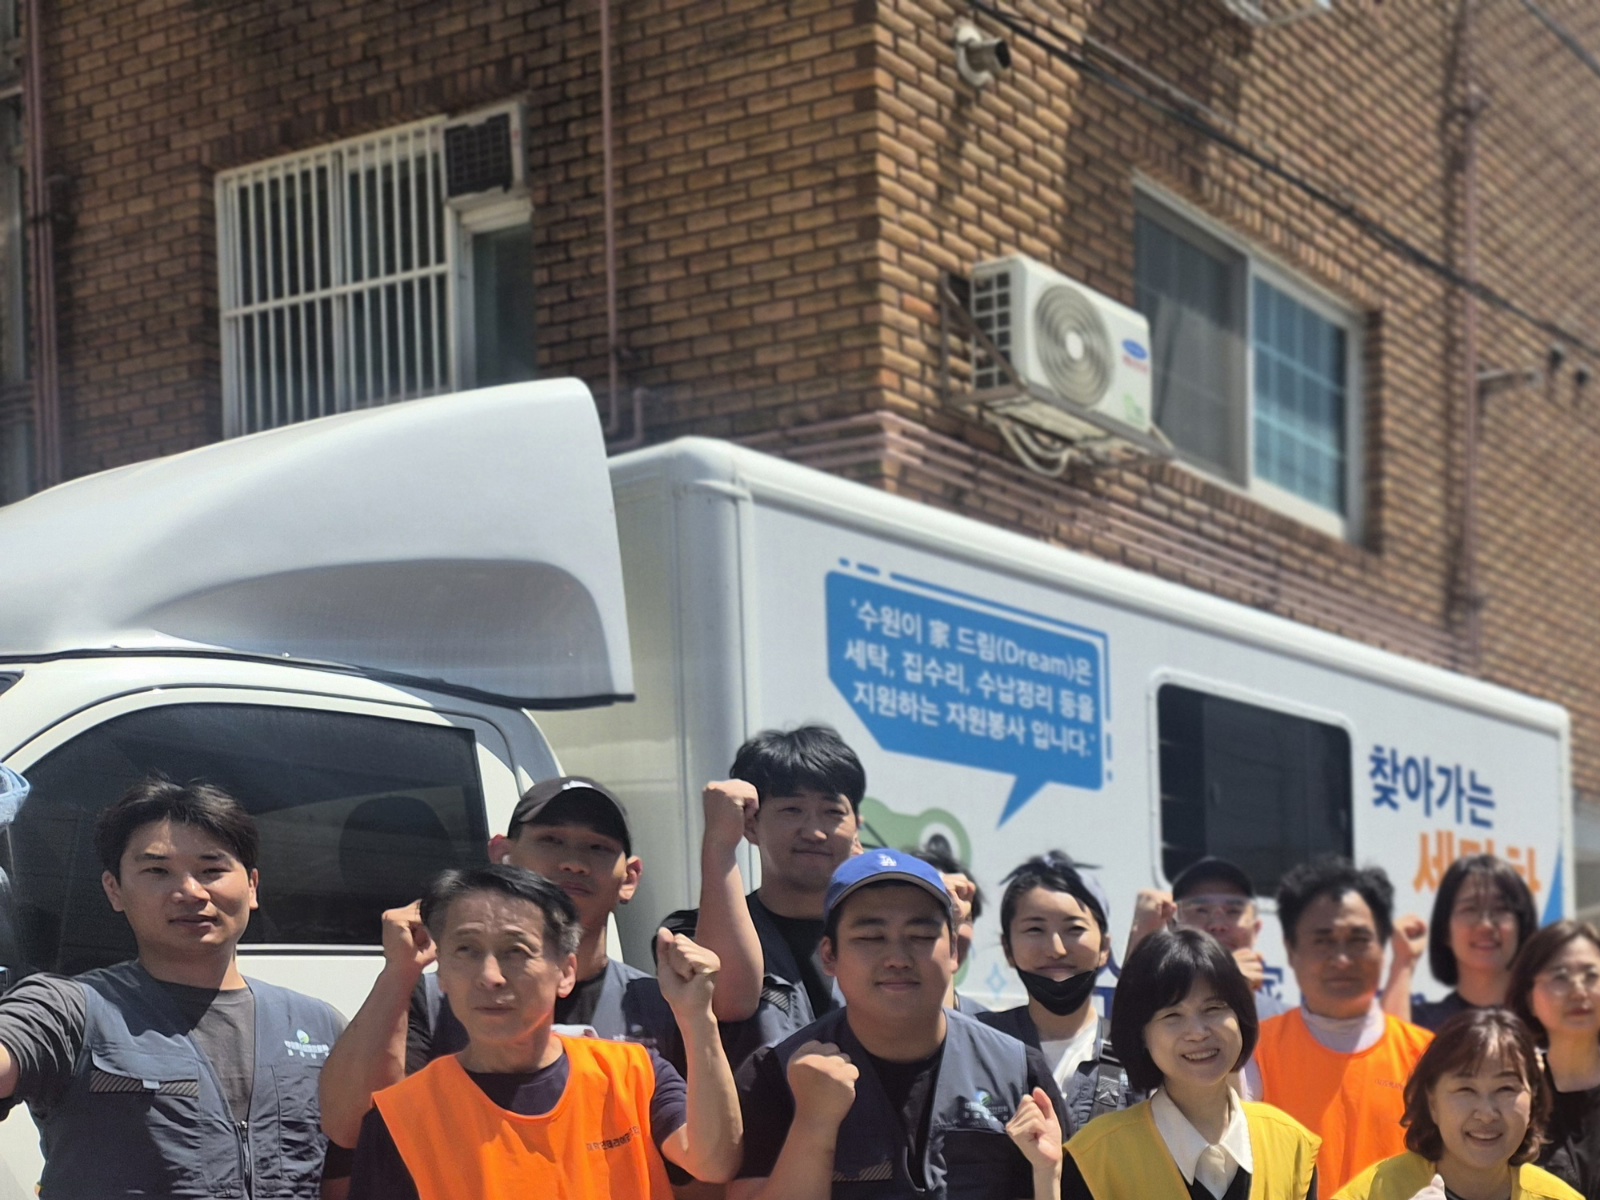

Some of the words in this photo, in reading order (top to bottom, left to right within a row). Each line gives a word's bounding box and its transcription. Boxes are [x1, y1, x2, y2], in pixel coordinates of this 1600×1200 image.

[956, 626, 1093, 686] 드림(Dream)은
[853, 681, 940, 727] 지원하는
[946, 702, 1026, 745] 자원봉사
[976, 670, 1053, 714] 수납정리
[1059, 688, 1094, 724] 등을
[1368, 744, 1496, 829] 찾아가는
